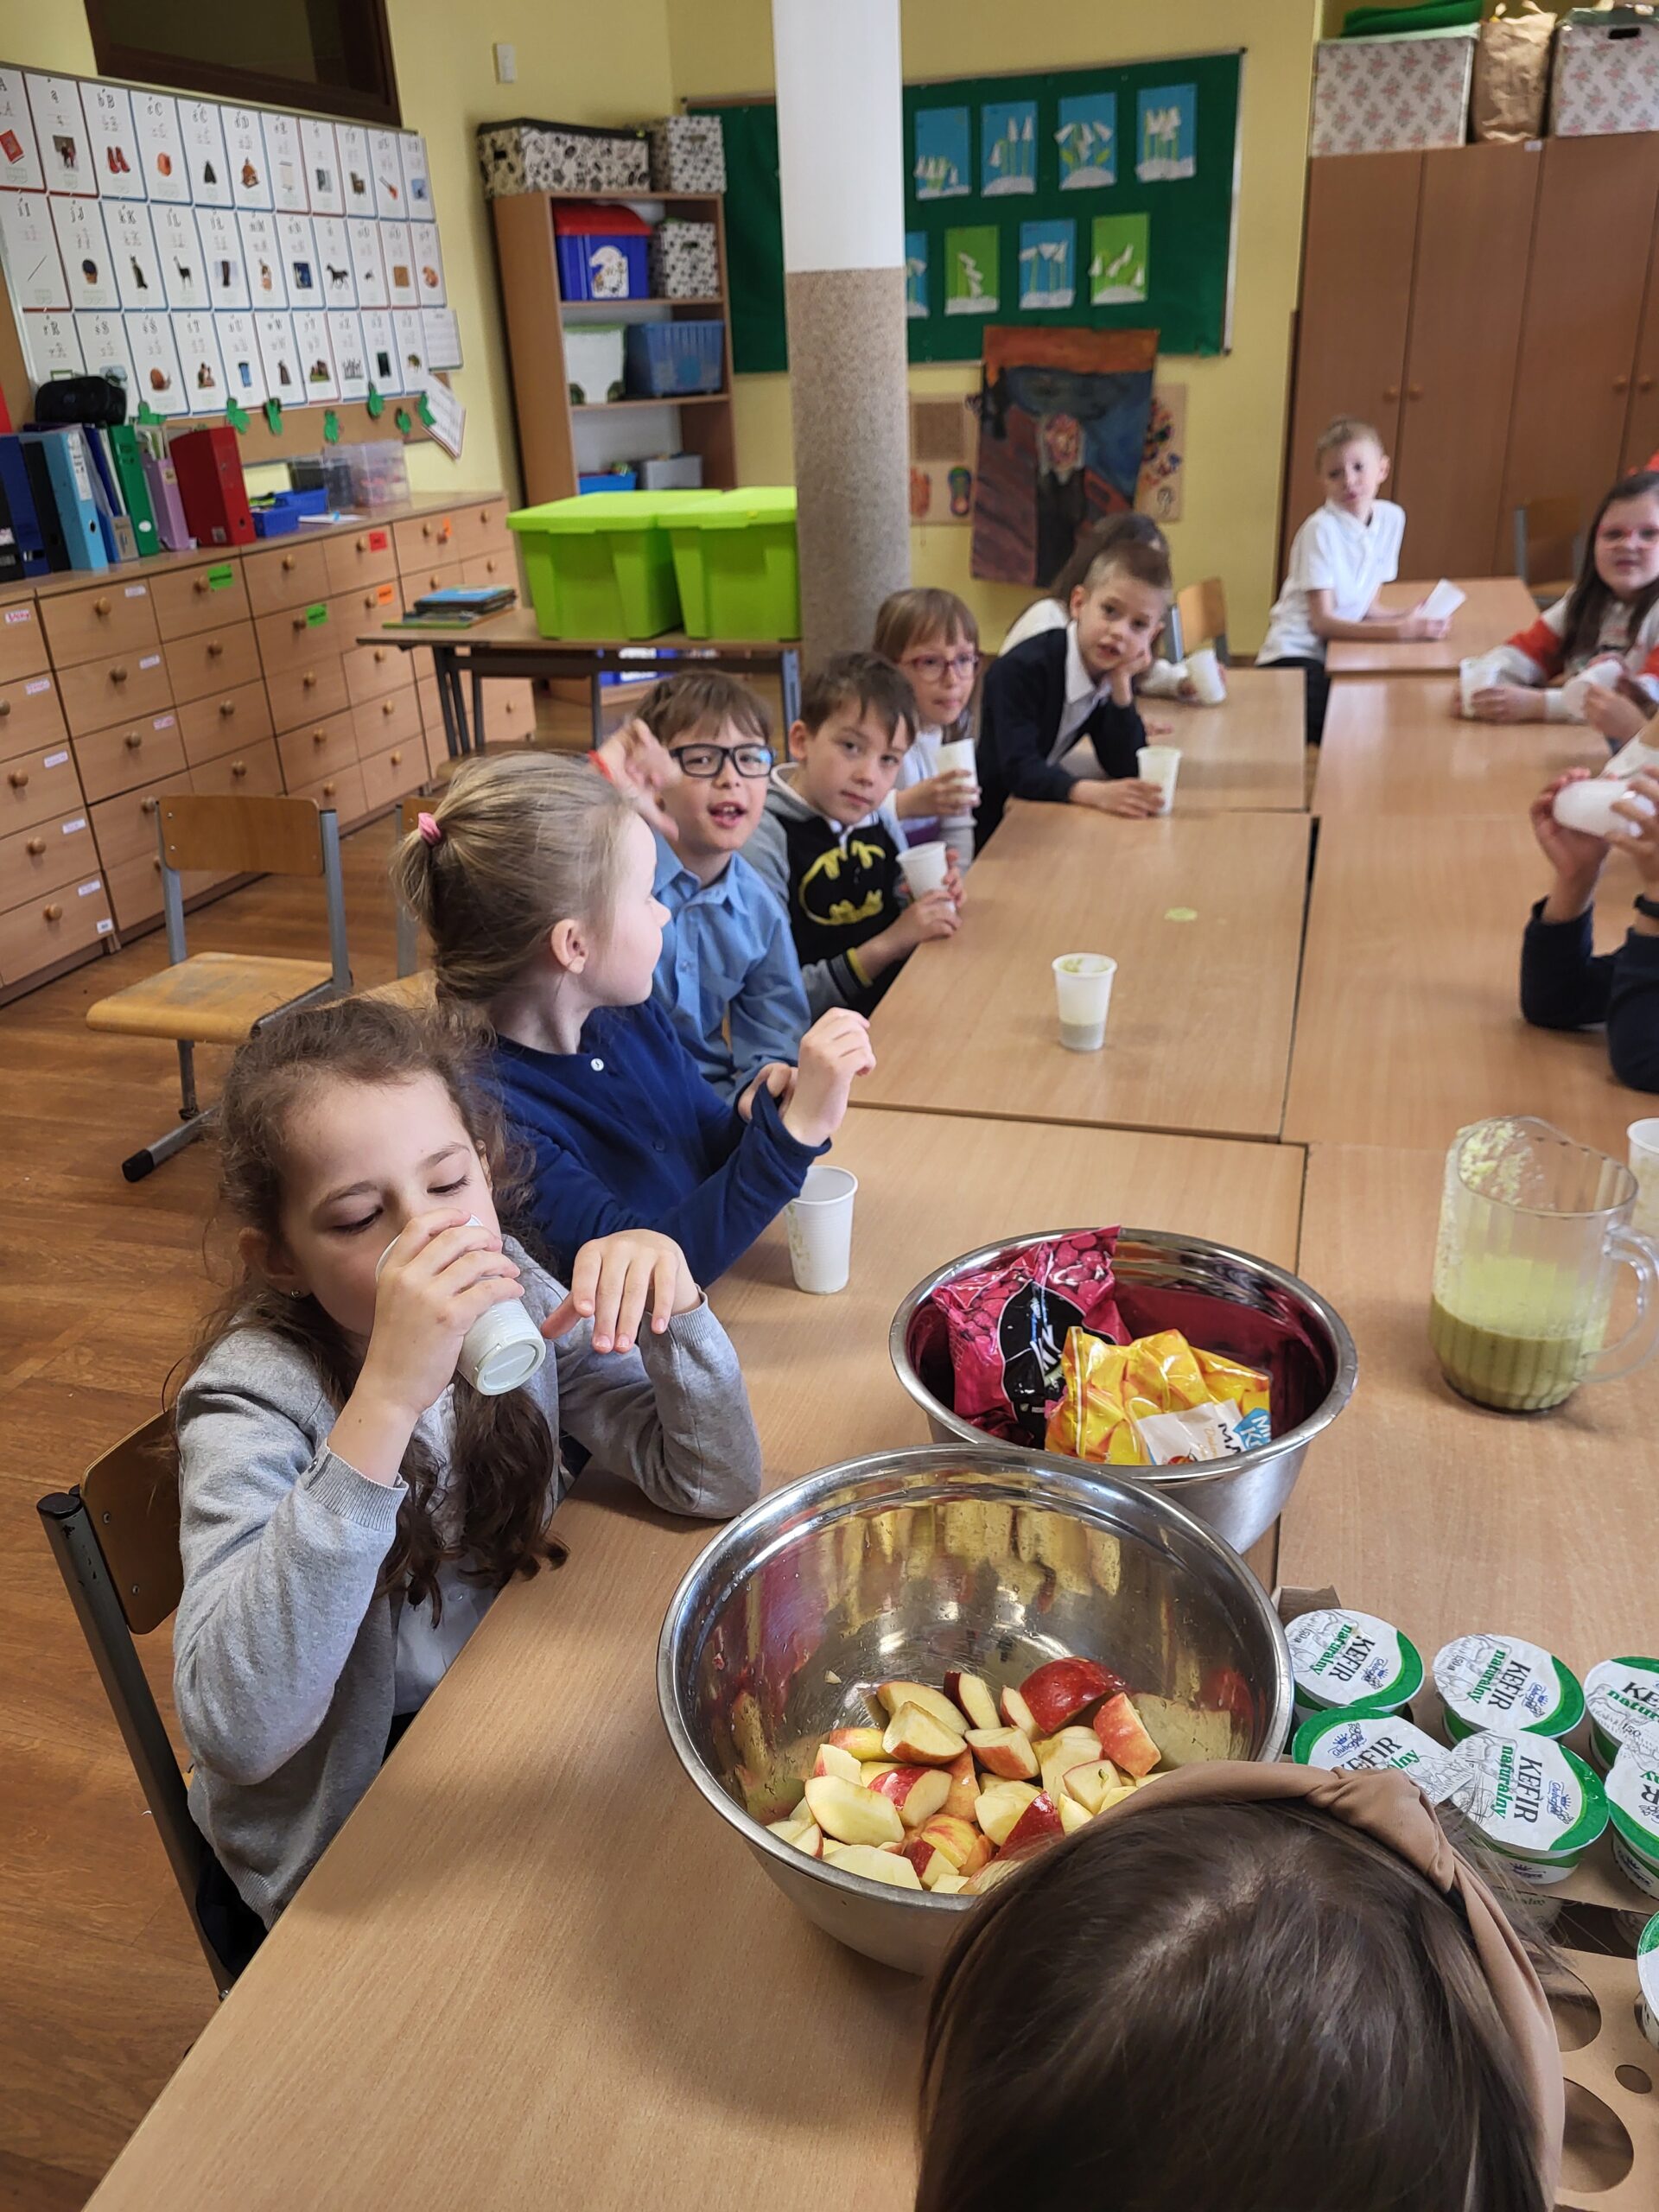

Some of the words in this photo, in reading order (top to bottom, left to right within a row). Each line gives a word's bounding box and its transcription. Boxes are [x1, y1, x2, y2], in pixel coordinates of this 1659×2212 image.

[1309, 1624, 1352, 1675] naturalny
[1328, 1635, 1376, 1681] KEFIR
[1466, 1649, 1506, 1704] naturalny
[1488, 1660, 1532, 1710] KEFIR
[1622, 1681, 1659, 1708] KE
[1607, 1689, 1659, 1723] natur
[1339, 1737, 1403, 1770] EFIR
[1491, 1745, 1514, 1820] naturalny
[1514, 1755, 1542, 1823] KEFIR
